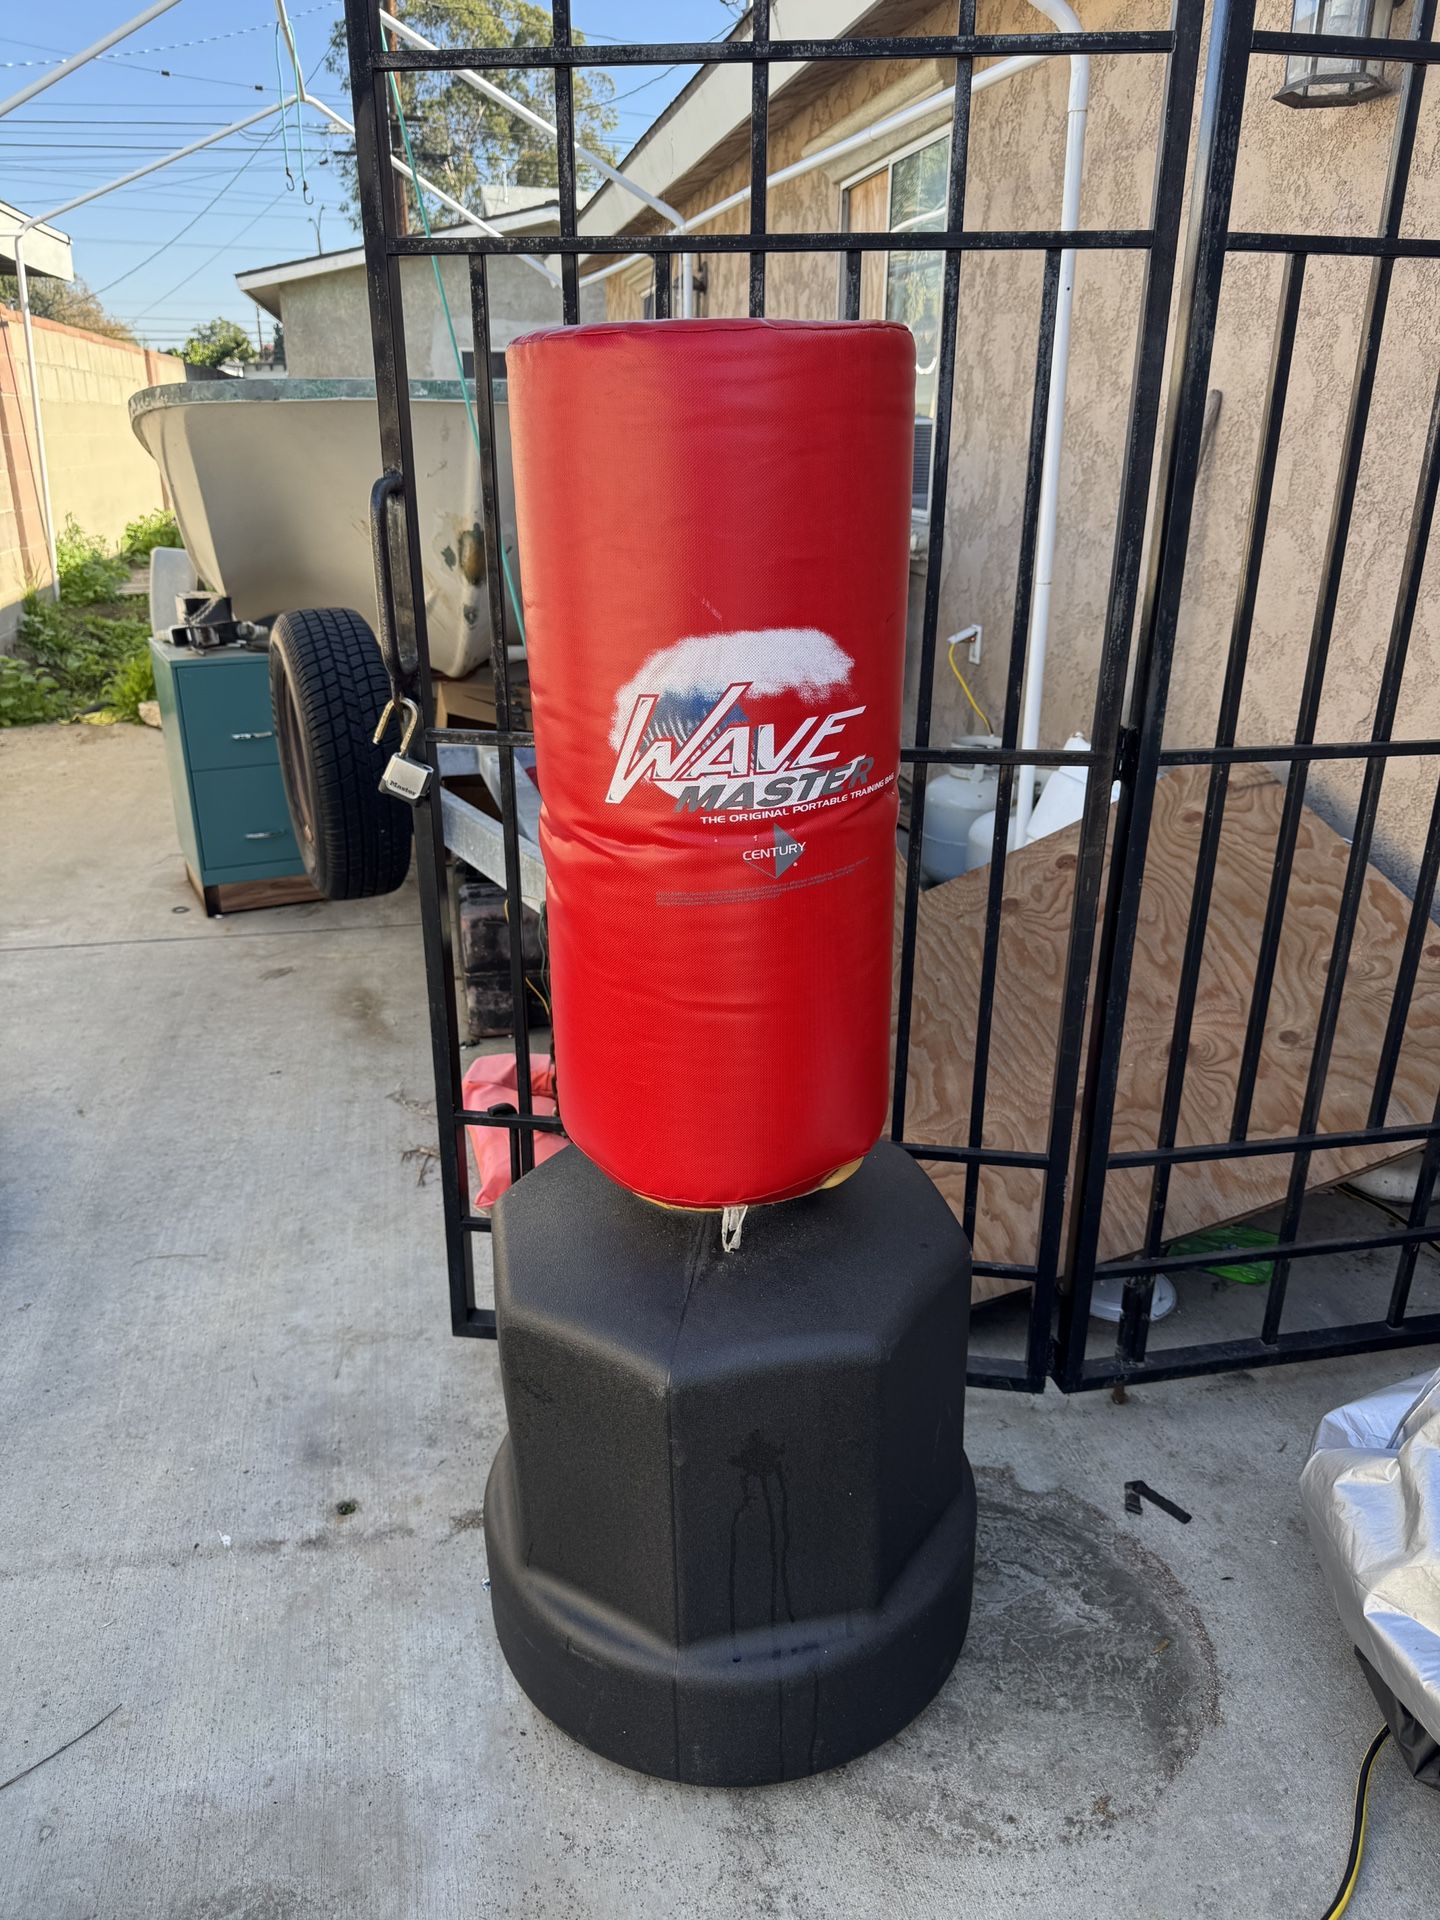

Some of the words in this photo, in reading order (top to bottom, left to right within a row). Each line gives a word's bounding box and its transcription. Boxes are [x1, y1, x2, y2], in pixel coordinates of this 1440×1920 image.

[605, 681, 866, 804] WAVE
[673, 756, 874, 813] MASTER
[700, 814, 726, 824] THE
[729, 807, 789, 823] ORIGINAL
[792, 795, 848, 814] PORTABLE
[850, 779, 884, 799] TRAINING
[742, 841, 807, 861] CENTURY
